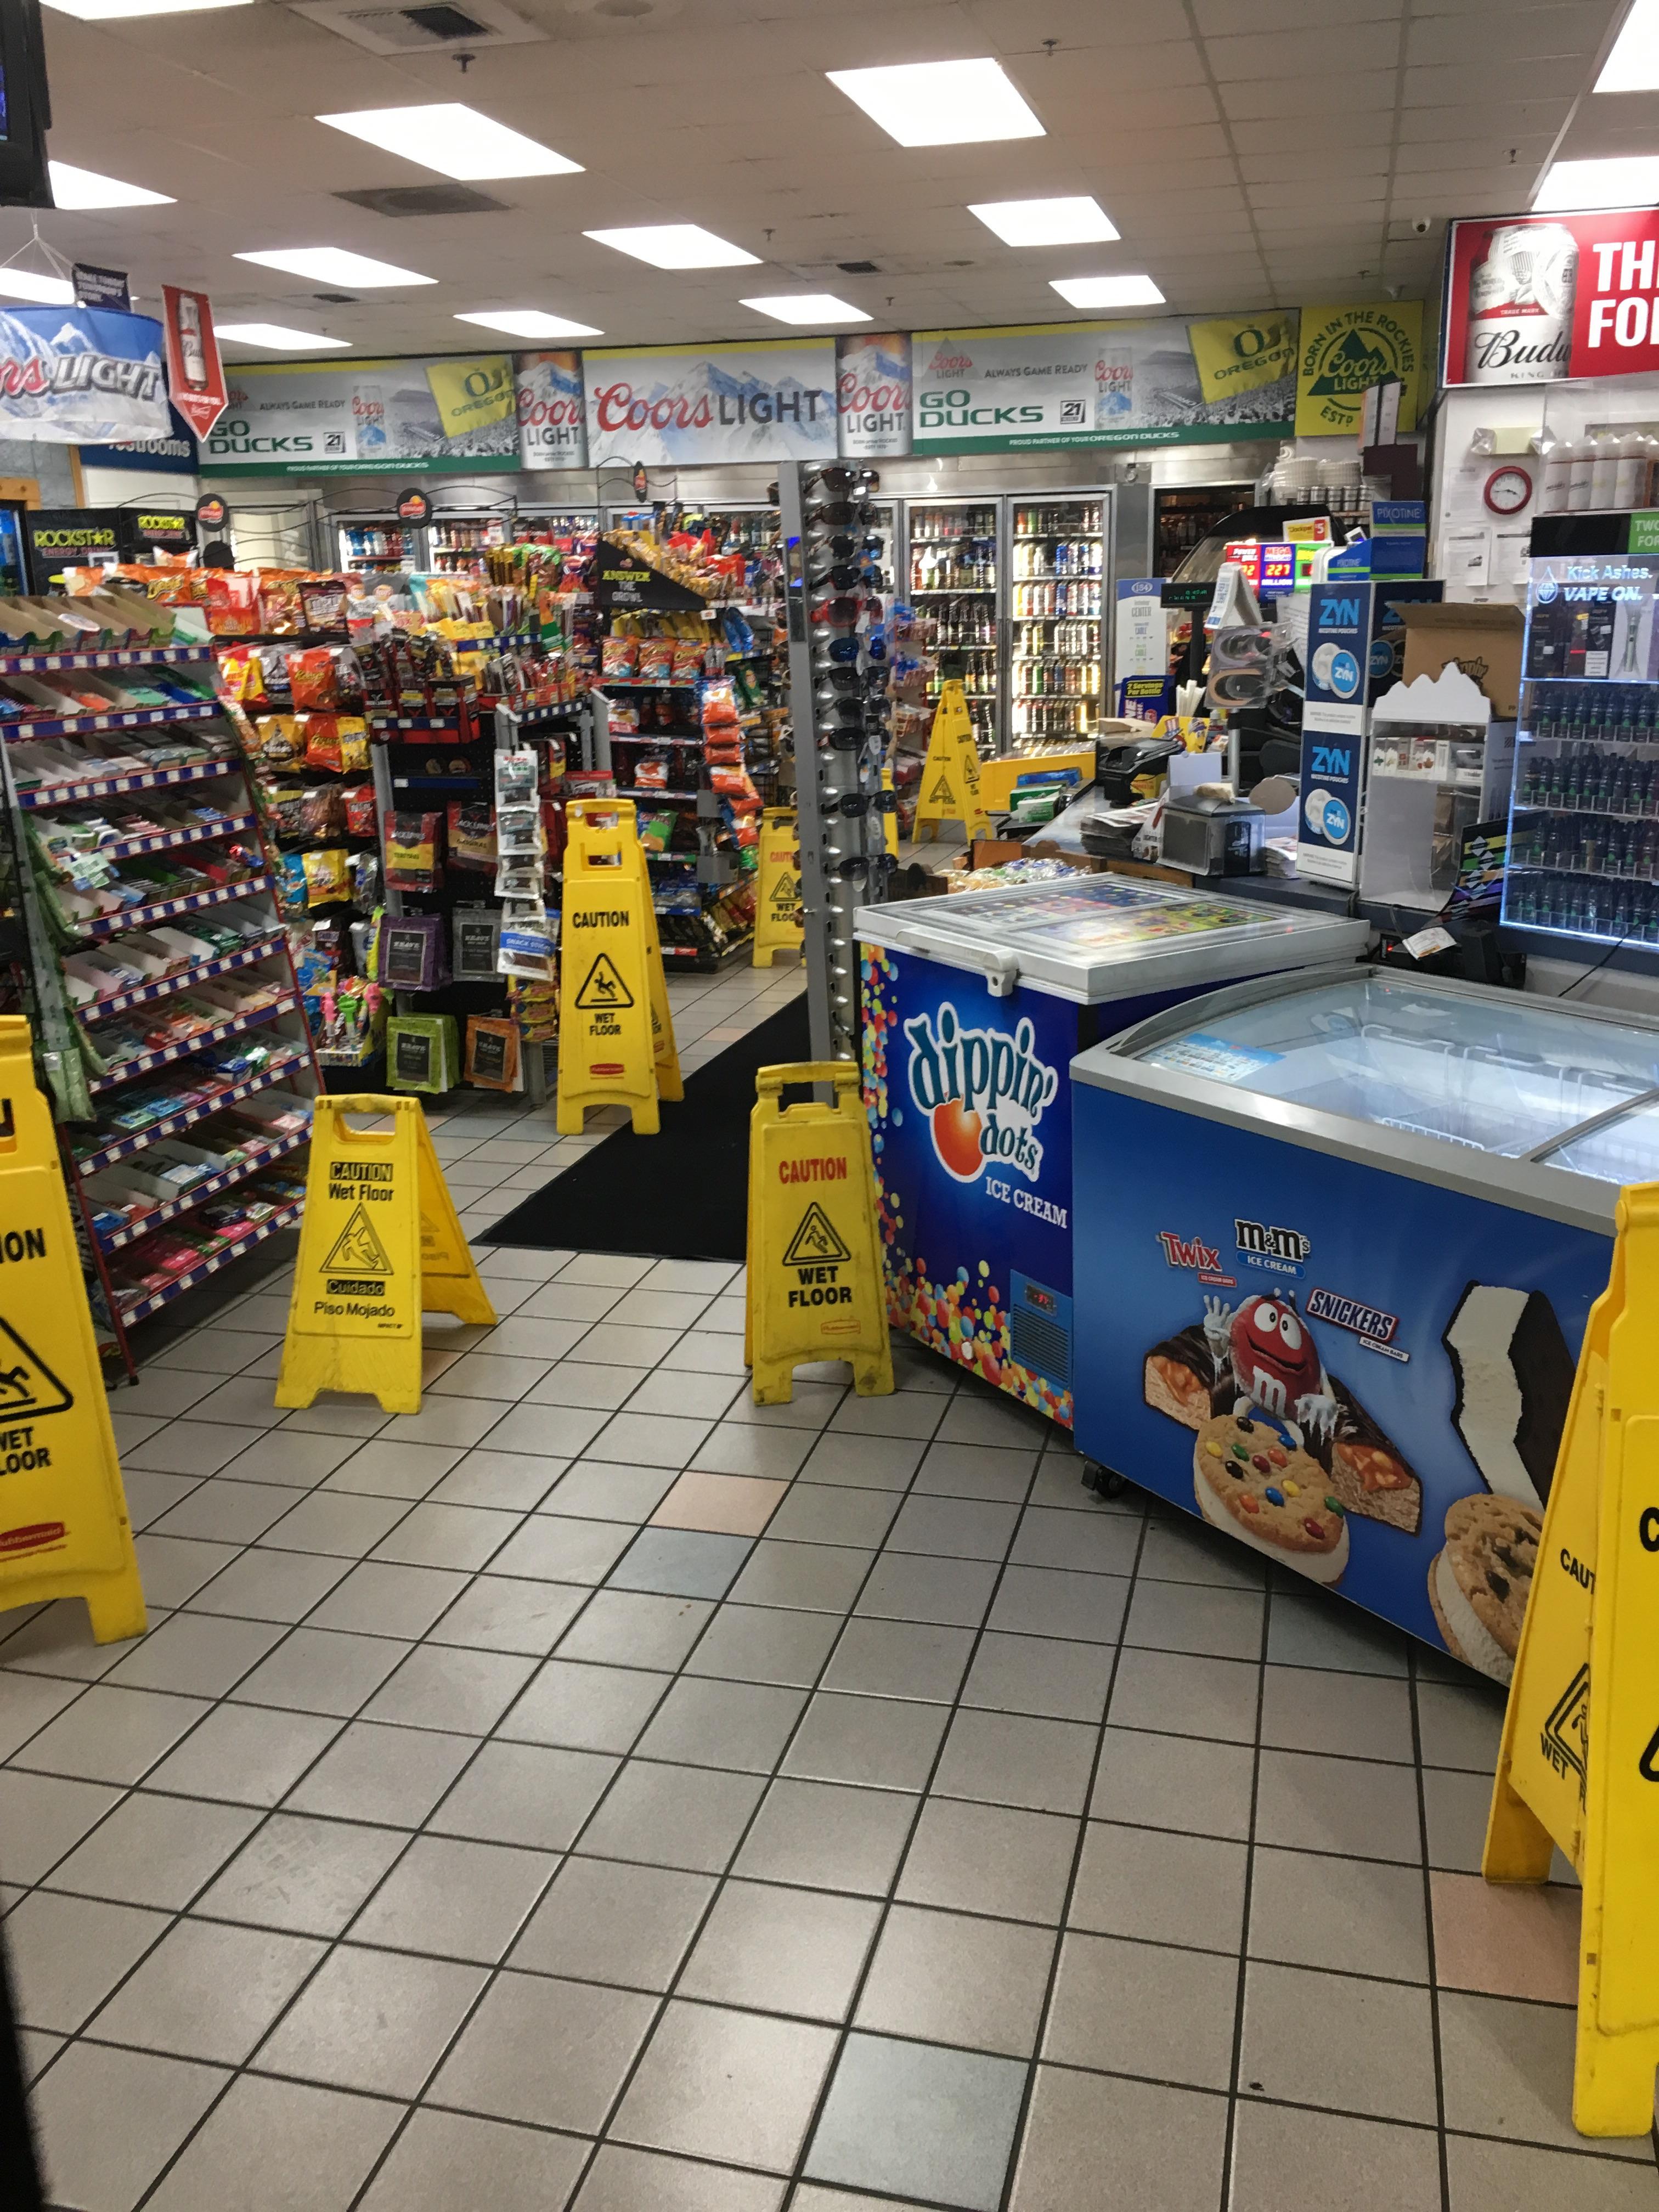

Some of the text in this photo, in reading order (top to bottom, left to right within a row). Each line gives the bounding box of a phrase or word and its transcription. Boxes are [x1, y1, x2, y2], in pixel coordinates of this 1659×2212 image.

[1593, 240, 1659, 292] TH
[1302, 311, 1415, 376] BORN IN THE ROCKIES
[928, 352, 973, 370] Coors
[54, 354, 161, 401] LIGHT
[936, 368, 965, 379] LIGHT
[984, 363, 1088, 378] ALWAYS GAME READY
[1098, 381, 1132, 393] LIGHT
[291, 400, 317, 409] GAME
[318, 399, 346, 409] READY
[594, 382, 822, 432] Coors LIGHT
[919, 389, 971, 408] GO
[919, 405, 1043, 428] DUCKS
[1063, 402, 1081, 416] 21
[210, 420, 250, 437] GO
[846, 412, 905, 433] LIGHT
[526, 426, 580, 445] LIGHT
[1090, 432, 1138, 442] OREGON
[209, 436, 313, 454] DUCKS
[1377, 507, 1422, 519] PIXOTINE
[1265, 546, 1291, 555] MEGA
[1567, 565, 1600, 580] Kick
[1563, 586, 1610, 601] VAPE
[1318, 598, 1361, 626] ZYN
[1334, 666, 1354, 682] ZYN
[1311, 746, 1351, 776] ZYN
[1325, 813, 1345, 830] ZYN
[770, 851, 793, 862] CAUTI
[776, 903, 796, 911] WET
[572, 910, 630, 928] CAUTION
[771, 913, 795, 922] FLOO
[594, 1013, 616, 1024] WET
[589, 1024, 621, 1036] FLOOR
[980, 1112, 1039, 1170] dots
[330, 1162, 394, 1182] CAUTION
[778, 1156, 848, 1184] CAUTION
[329, 1182, 394, 1201] Wet Floor
[985, 1176, 1068, 1229] ICE CREAM
[1161, 1231, 1223, 1272] Twix
[1246, 1254, 1297, 1276] ICE CREAM
[797, 1266, 839, 1285] WET
[328, 1280, 385, 1295] Cuidado
[788, 1286, 852, 1308] FLOOR
[314, 1301, 396, 1319] Piso Mojado
[1311, 1290, 1393, 1341] SNICKERS
[0, 1527, 63, 1548] ubbermaid
[1540, 1732, 1568, 1780] WET
